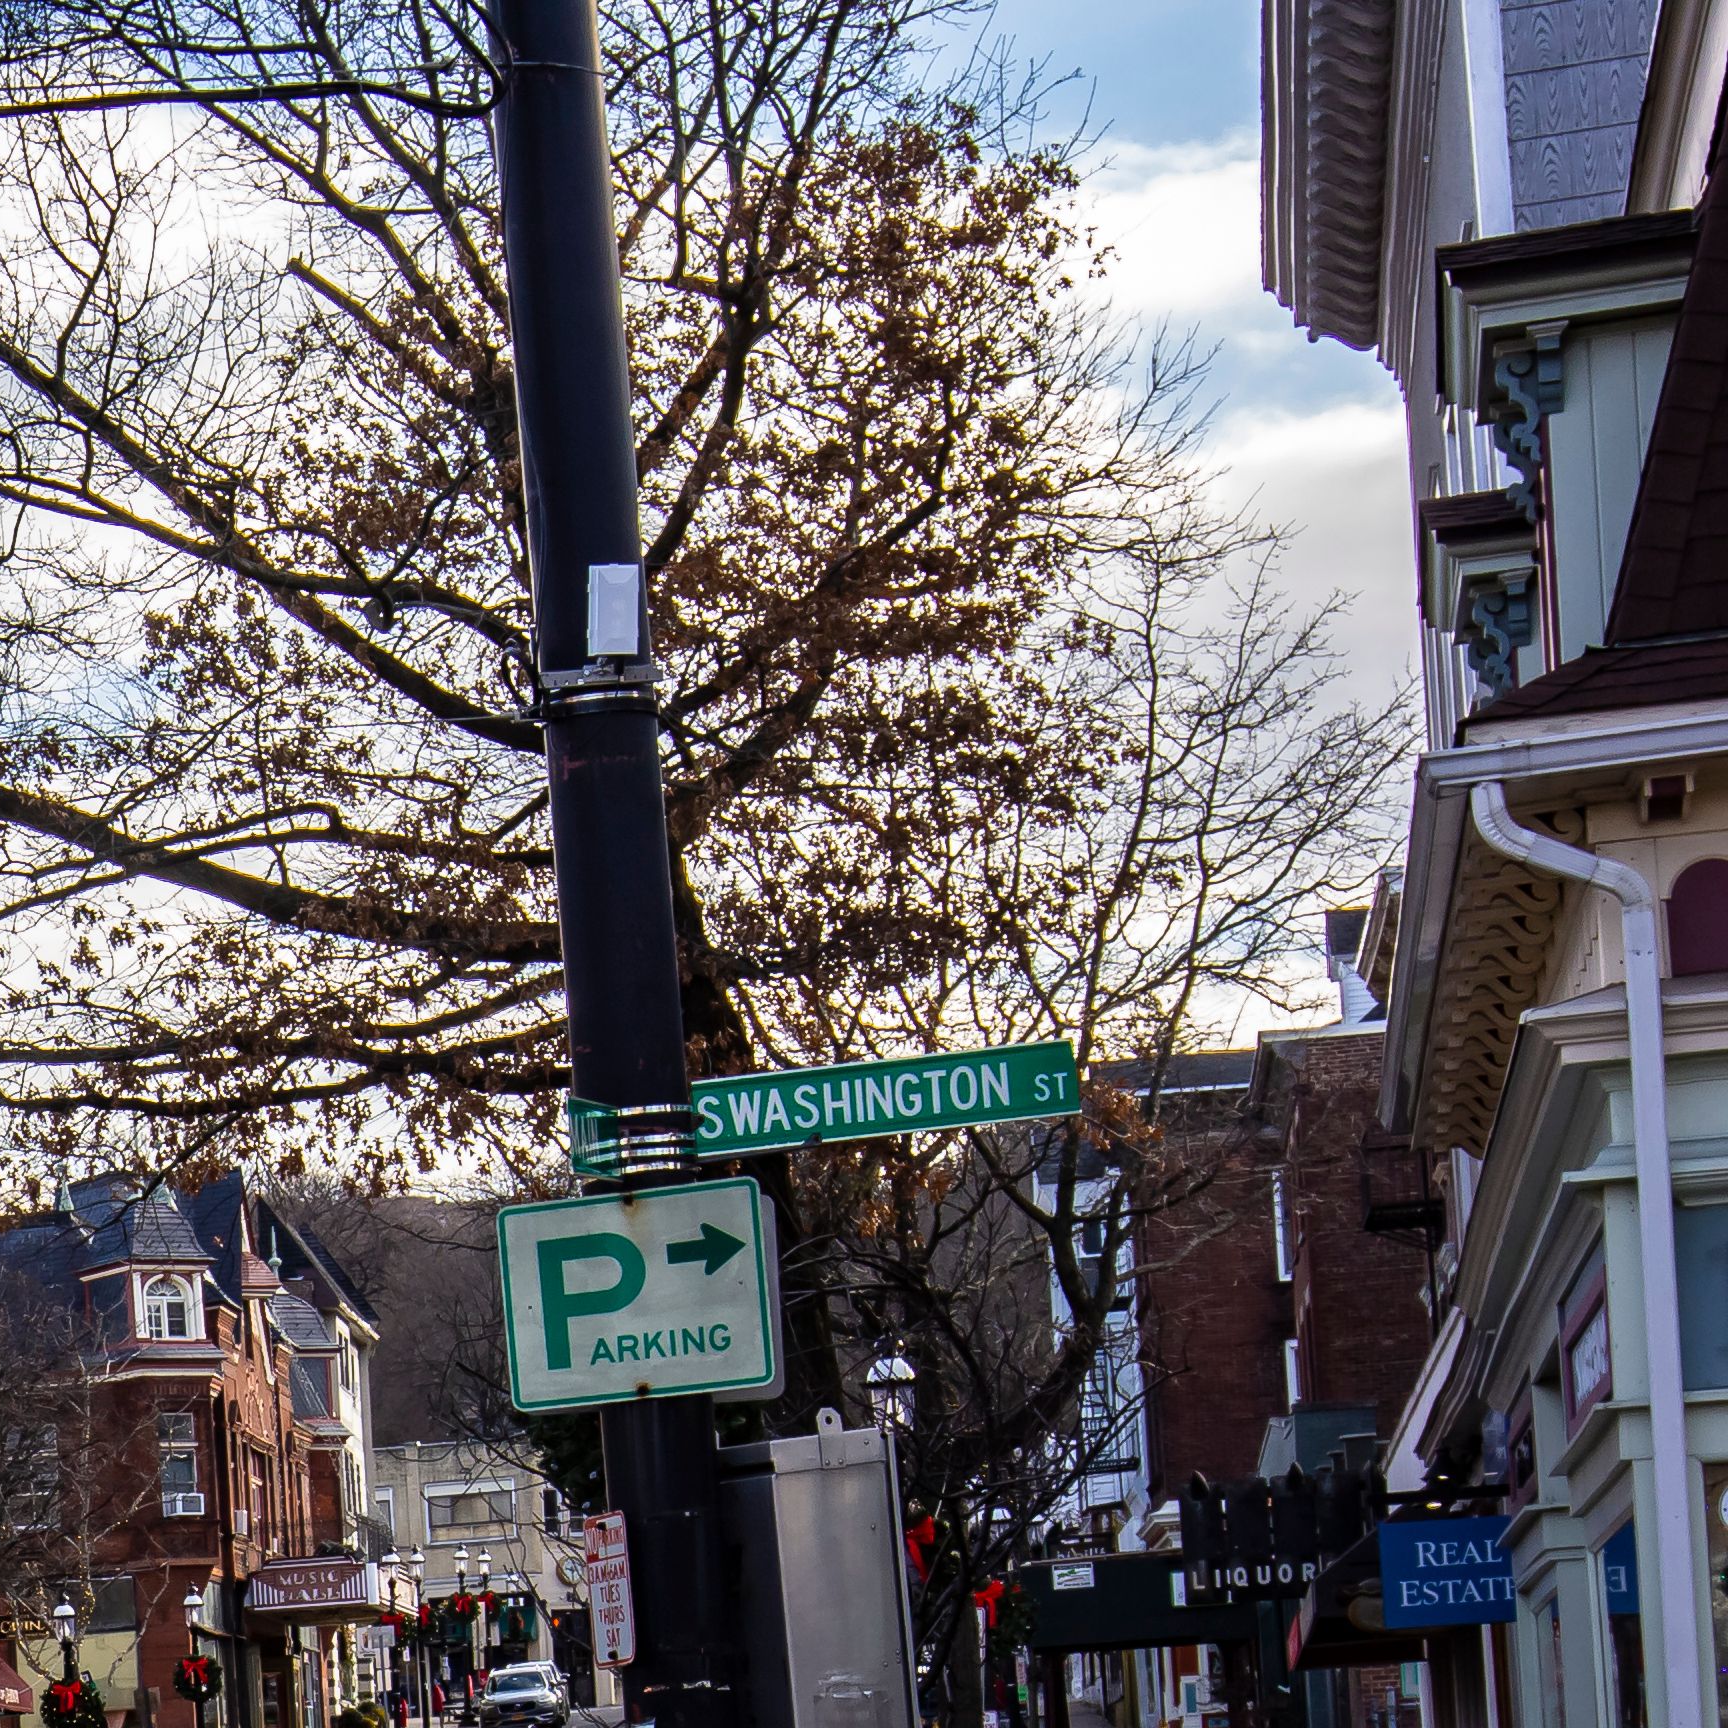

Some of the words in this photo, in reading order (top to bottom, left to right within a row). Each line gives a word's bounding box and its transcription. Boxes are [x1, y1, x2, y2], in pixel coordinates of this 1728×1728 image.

[1034, 1072, 1068, 1102] ST
[1414, 1539, 1503, 1569] REAL
[279, 1570, 339, 1586] MUSIC
[1193, 1562, 1321, 1591] LIQUOR
[279, 1587, 341, 1604] HALL
[600, 1584, 621, 1604] TUES
[606, 1628, 621, 1649] SAT
